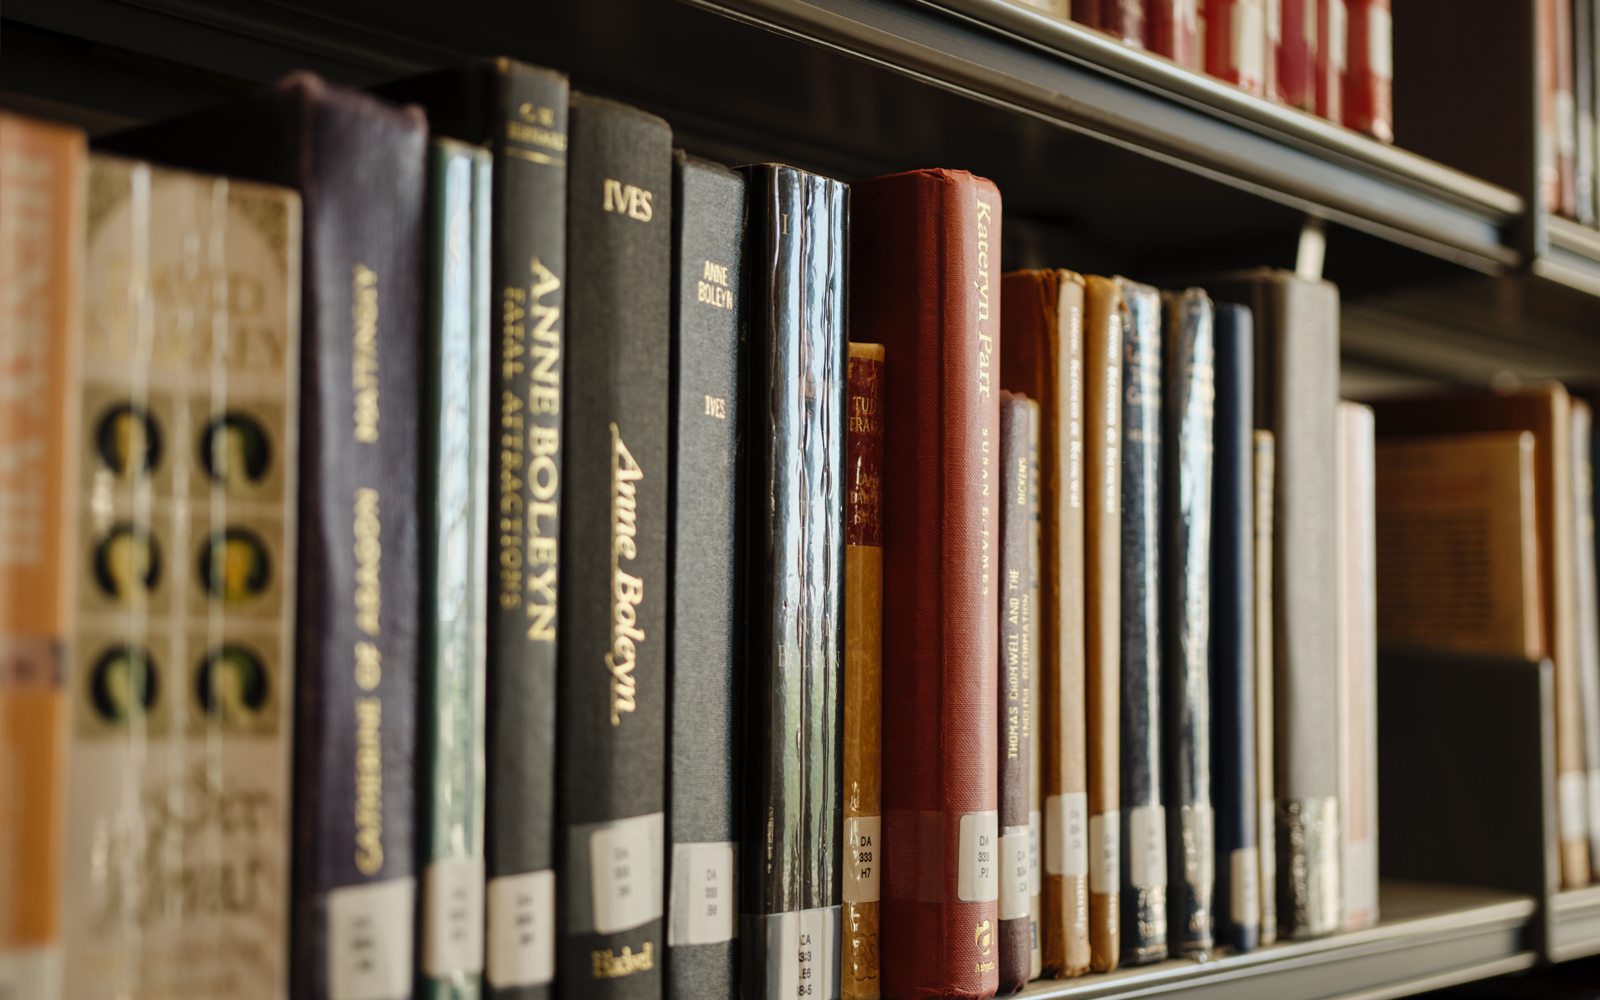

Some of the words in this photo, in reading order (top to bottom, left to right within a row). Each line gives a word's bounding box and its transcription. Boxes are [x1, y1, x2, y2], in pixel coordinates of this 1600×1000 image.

[603, 179, 653, 223] IVES
[703, 260, 729, 287] ANNE
[974, 198, 991, 321] Kateryn
[697, 280, 733, 310] BOLEYN
[503, 287, 526, 380] FATAL
[529, 258, 561, 415] ANNE
[978, 331, 992, 398] Parr
[704, 395, 726, 420] IVES
[981, 428, 989, 496] SUSAN
[1017, 457, 1027, 505] DICKENS
[499, 390, 524, 610] ATTRACTIONS
[615, 438, 644, 561] Anne
[526, 425, 559, 642] BOLEYN
[981, 530, 989, 596] JAMES
[1009, 569, 1020, 590] THE
[1009, 598, 1019, 624] AND
[604, 568, 645, 713] Boleyn
[1008, 633, 1019, 700] CROMWELL
[1008, 707, 1019, 759] THOMAS
[859, 853, 872, 863] 333
[860, 836, 872, 847] DA
[977, 852, 990, 862] 333
[979, 835, 990, 846] DA
[861, 868, 871, 879] H7
[978, 868, 990, 878] .P2
